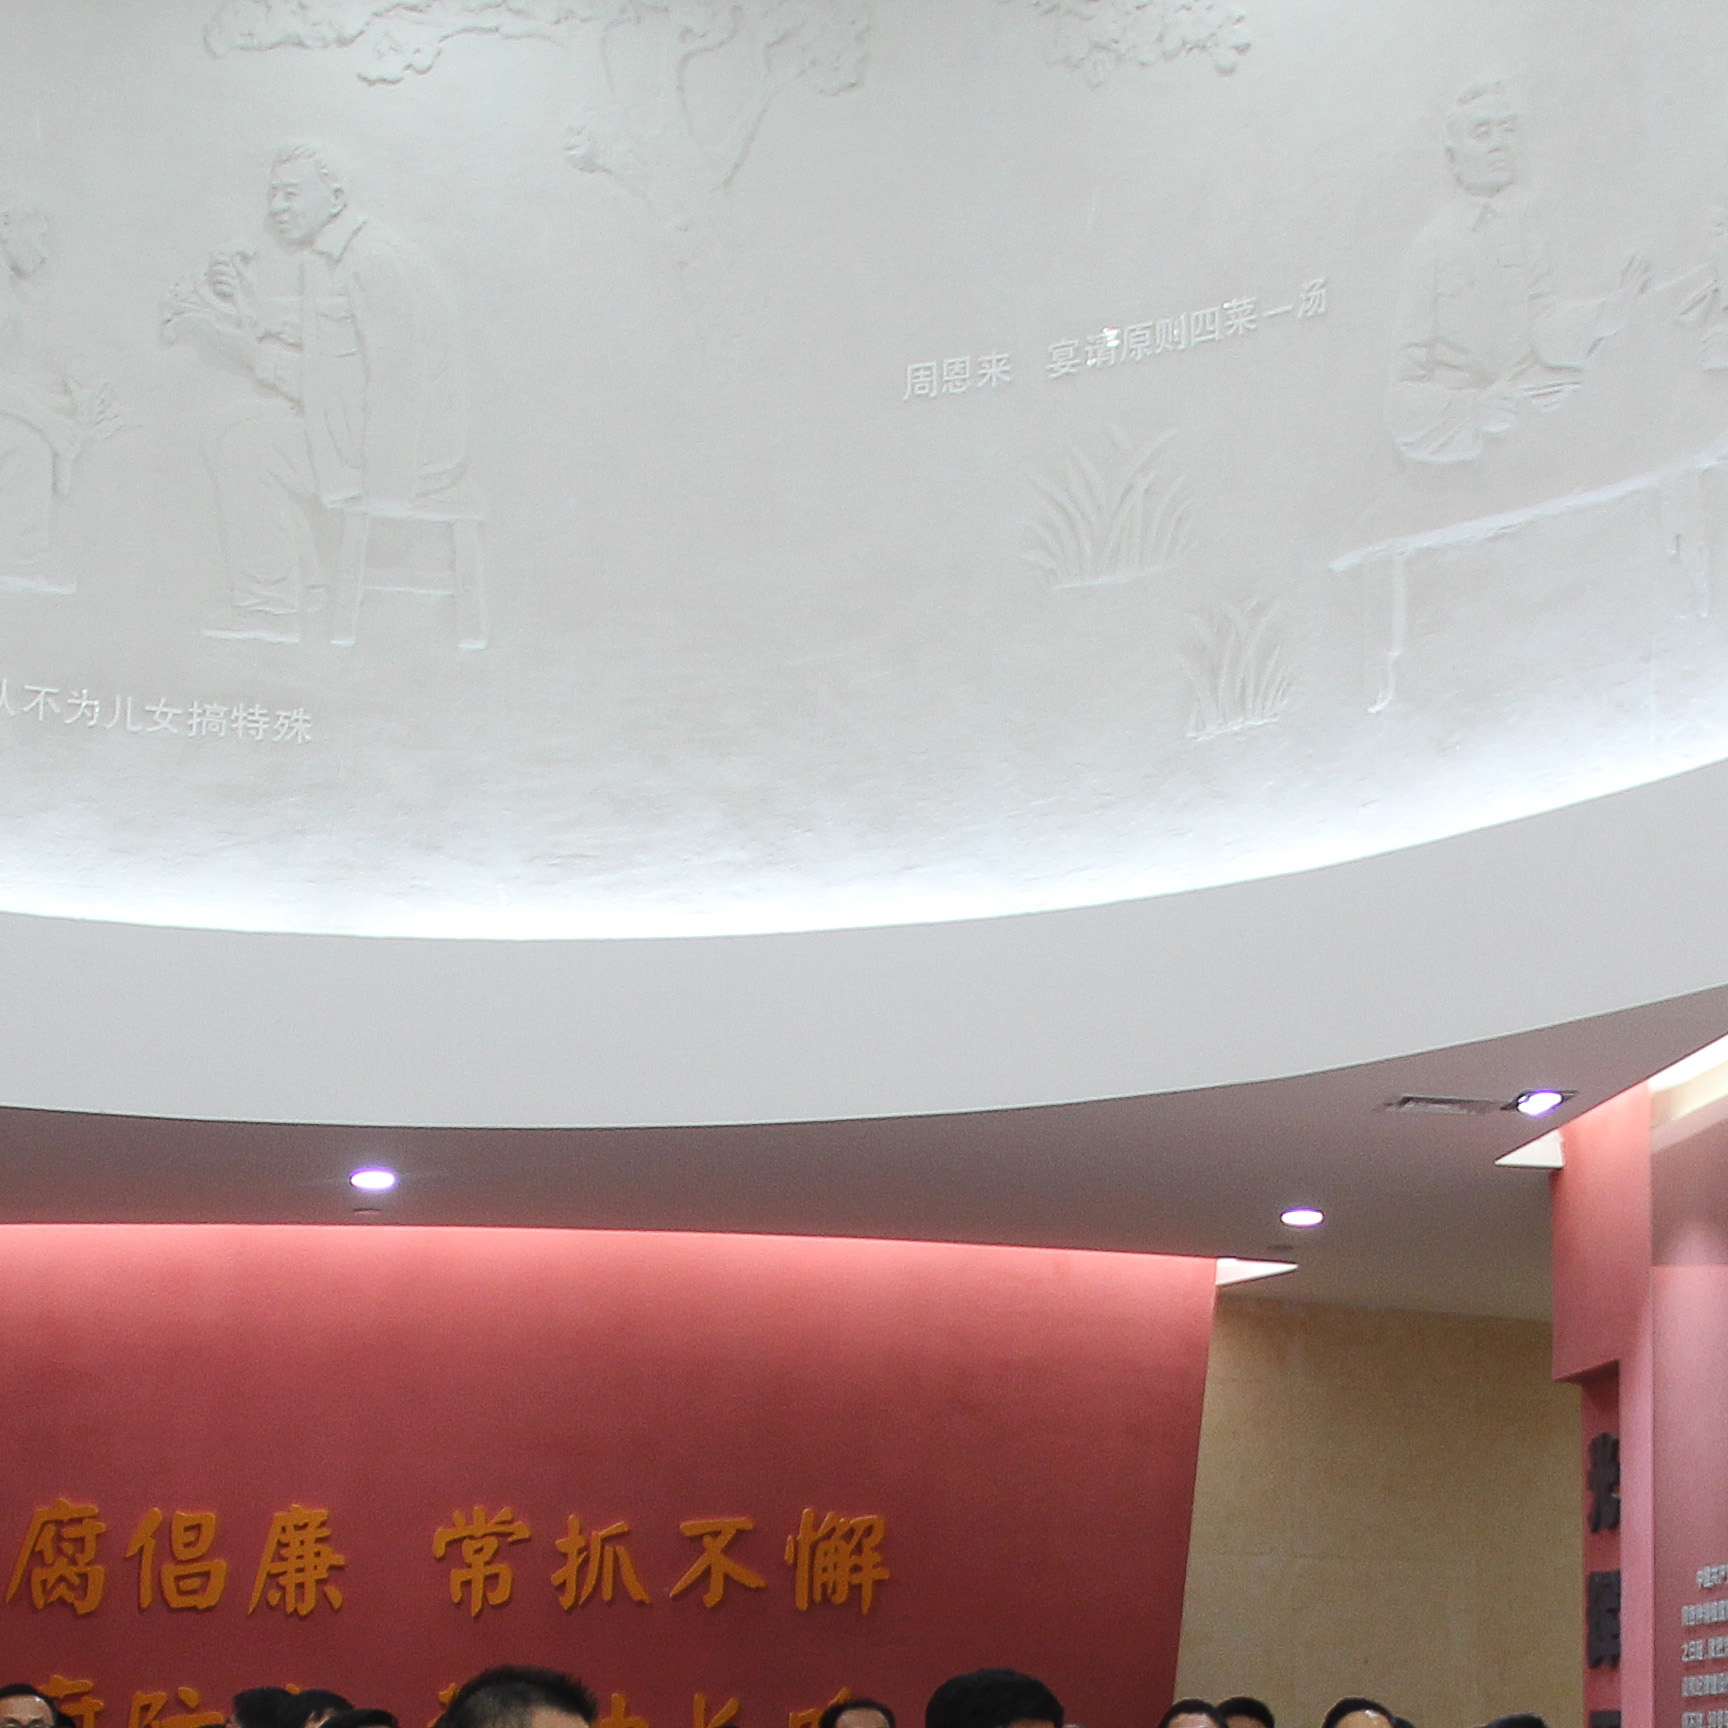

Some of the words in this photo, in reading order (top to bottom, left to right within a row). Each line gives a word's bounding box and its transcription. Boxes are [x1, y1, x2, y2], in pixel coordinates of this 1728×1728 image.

[902, 350, 1014, 402] 周恩来
[1044, 276, 1330, 380] 宴请原则四菜一汤
[431, 1504, 892, 1618] 常抓不懈
